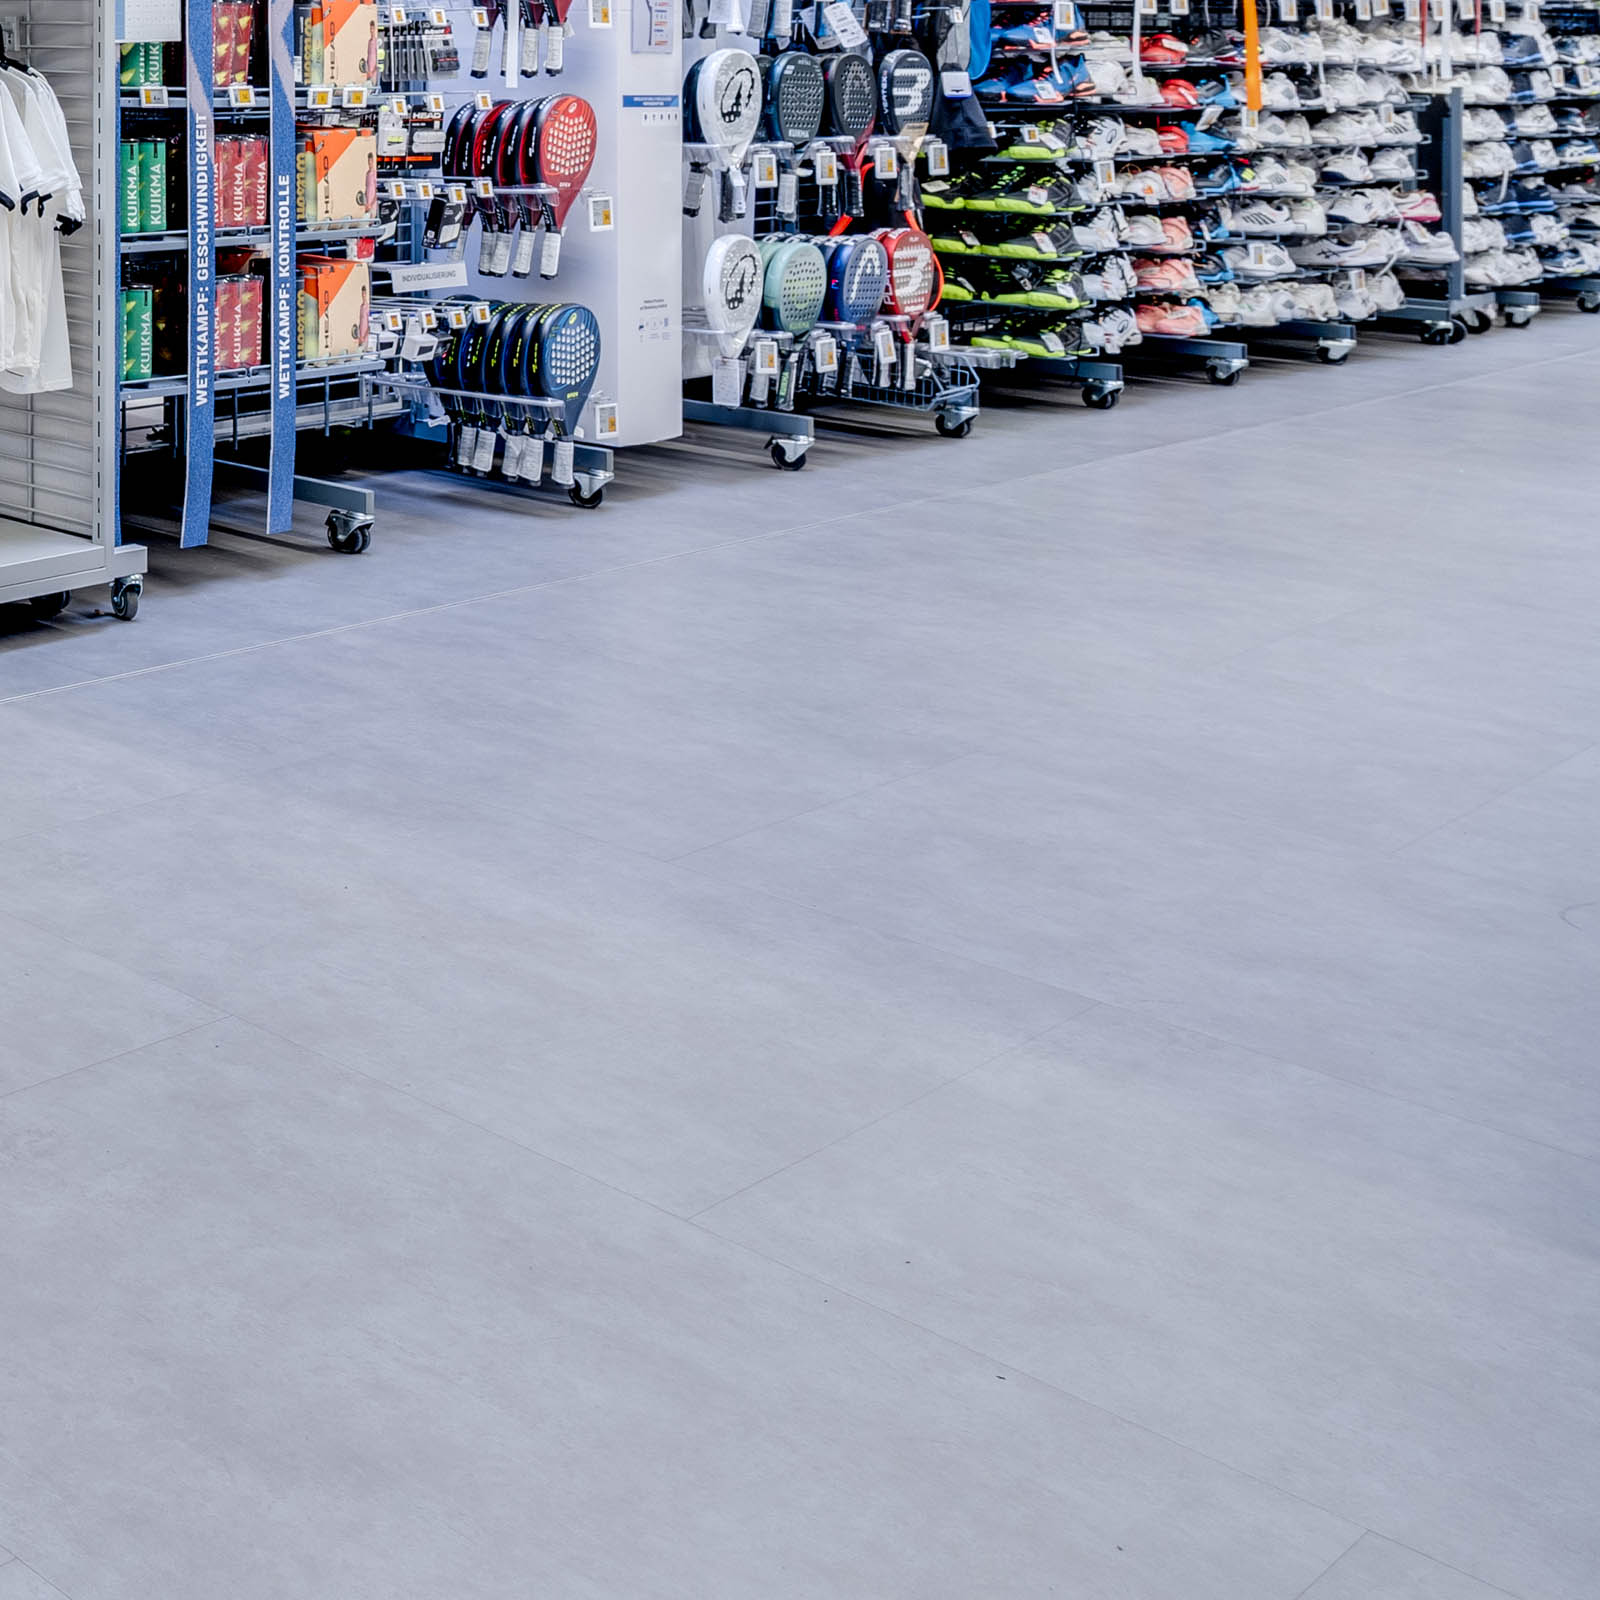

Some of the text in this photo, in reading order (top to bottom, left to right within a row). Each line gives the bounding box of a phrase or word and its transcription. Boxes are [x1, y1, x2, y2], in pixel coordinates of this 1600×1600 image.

[412, 111, 442, 120] HEAD
[128, 165, 137, 228] KUIKMA
[150, 163, 162, 225] KUIKMA
[233, 162, 244, 222] KUIKMA
[256, 161, 267, 220] KUIKMA
[195, 113, 209, 406] WETTKAMPF: GESCHWINDIGKEIT
[278, 174, 290, 399] WETTKAMPF: KONTROLLE
[140, 311, 151, 374] KUIKMA
[233, 303, 242, 363] KUIKMA
